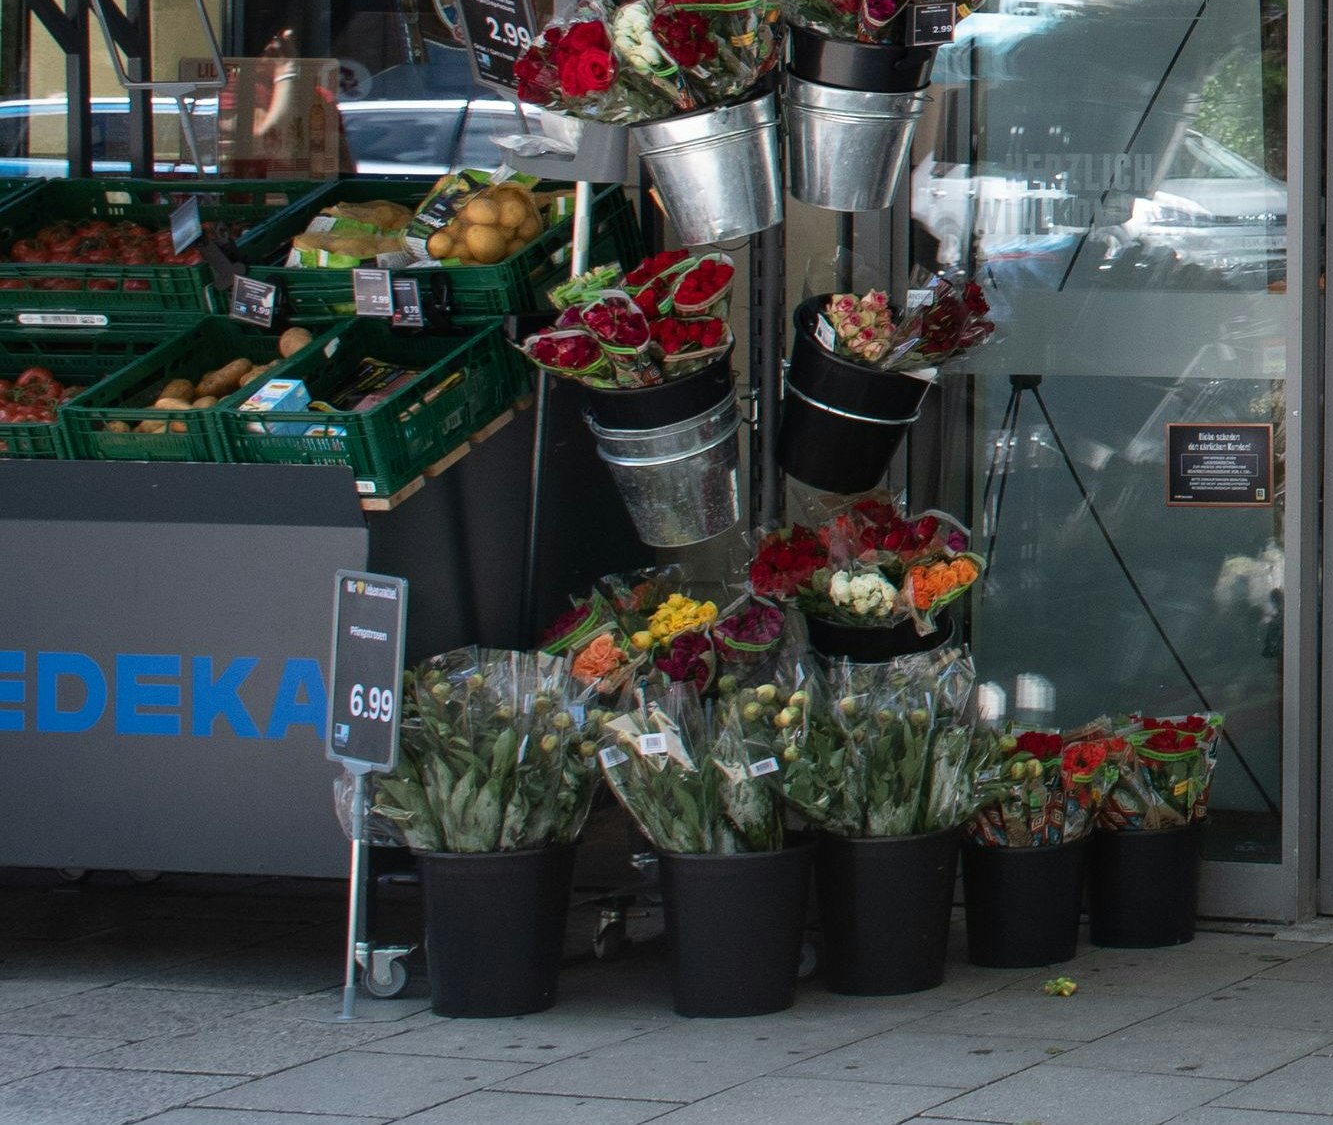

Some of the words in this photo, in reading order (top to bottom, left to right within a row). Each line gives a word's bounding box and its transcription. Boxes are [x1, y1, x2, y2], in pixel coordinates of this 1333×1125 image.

[485, 15, 533, 50] 2.99
[932, 25, 953, 33] 2.99
[371, 295, 390, 304] 2.99
[350, 625, 388, 642] Pfingstrosen
[350, 683, 394, 723] 6.99
